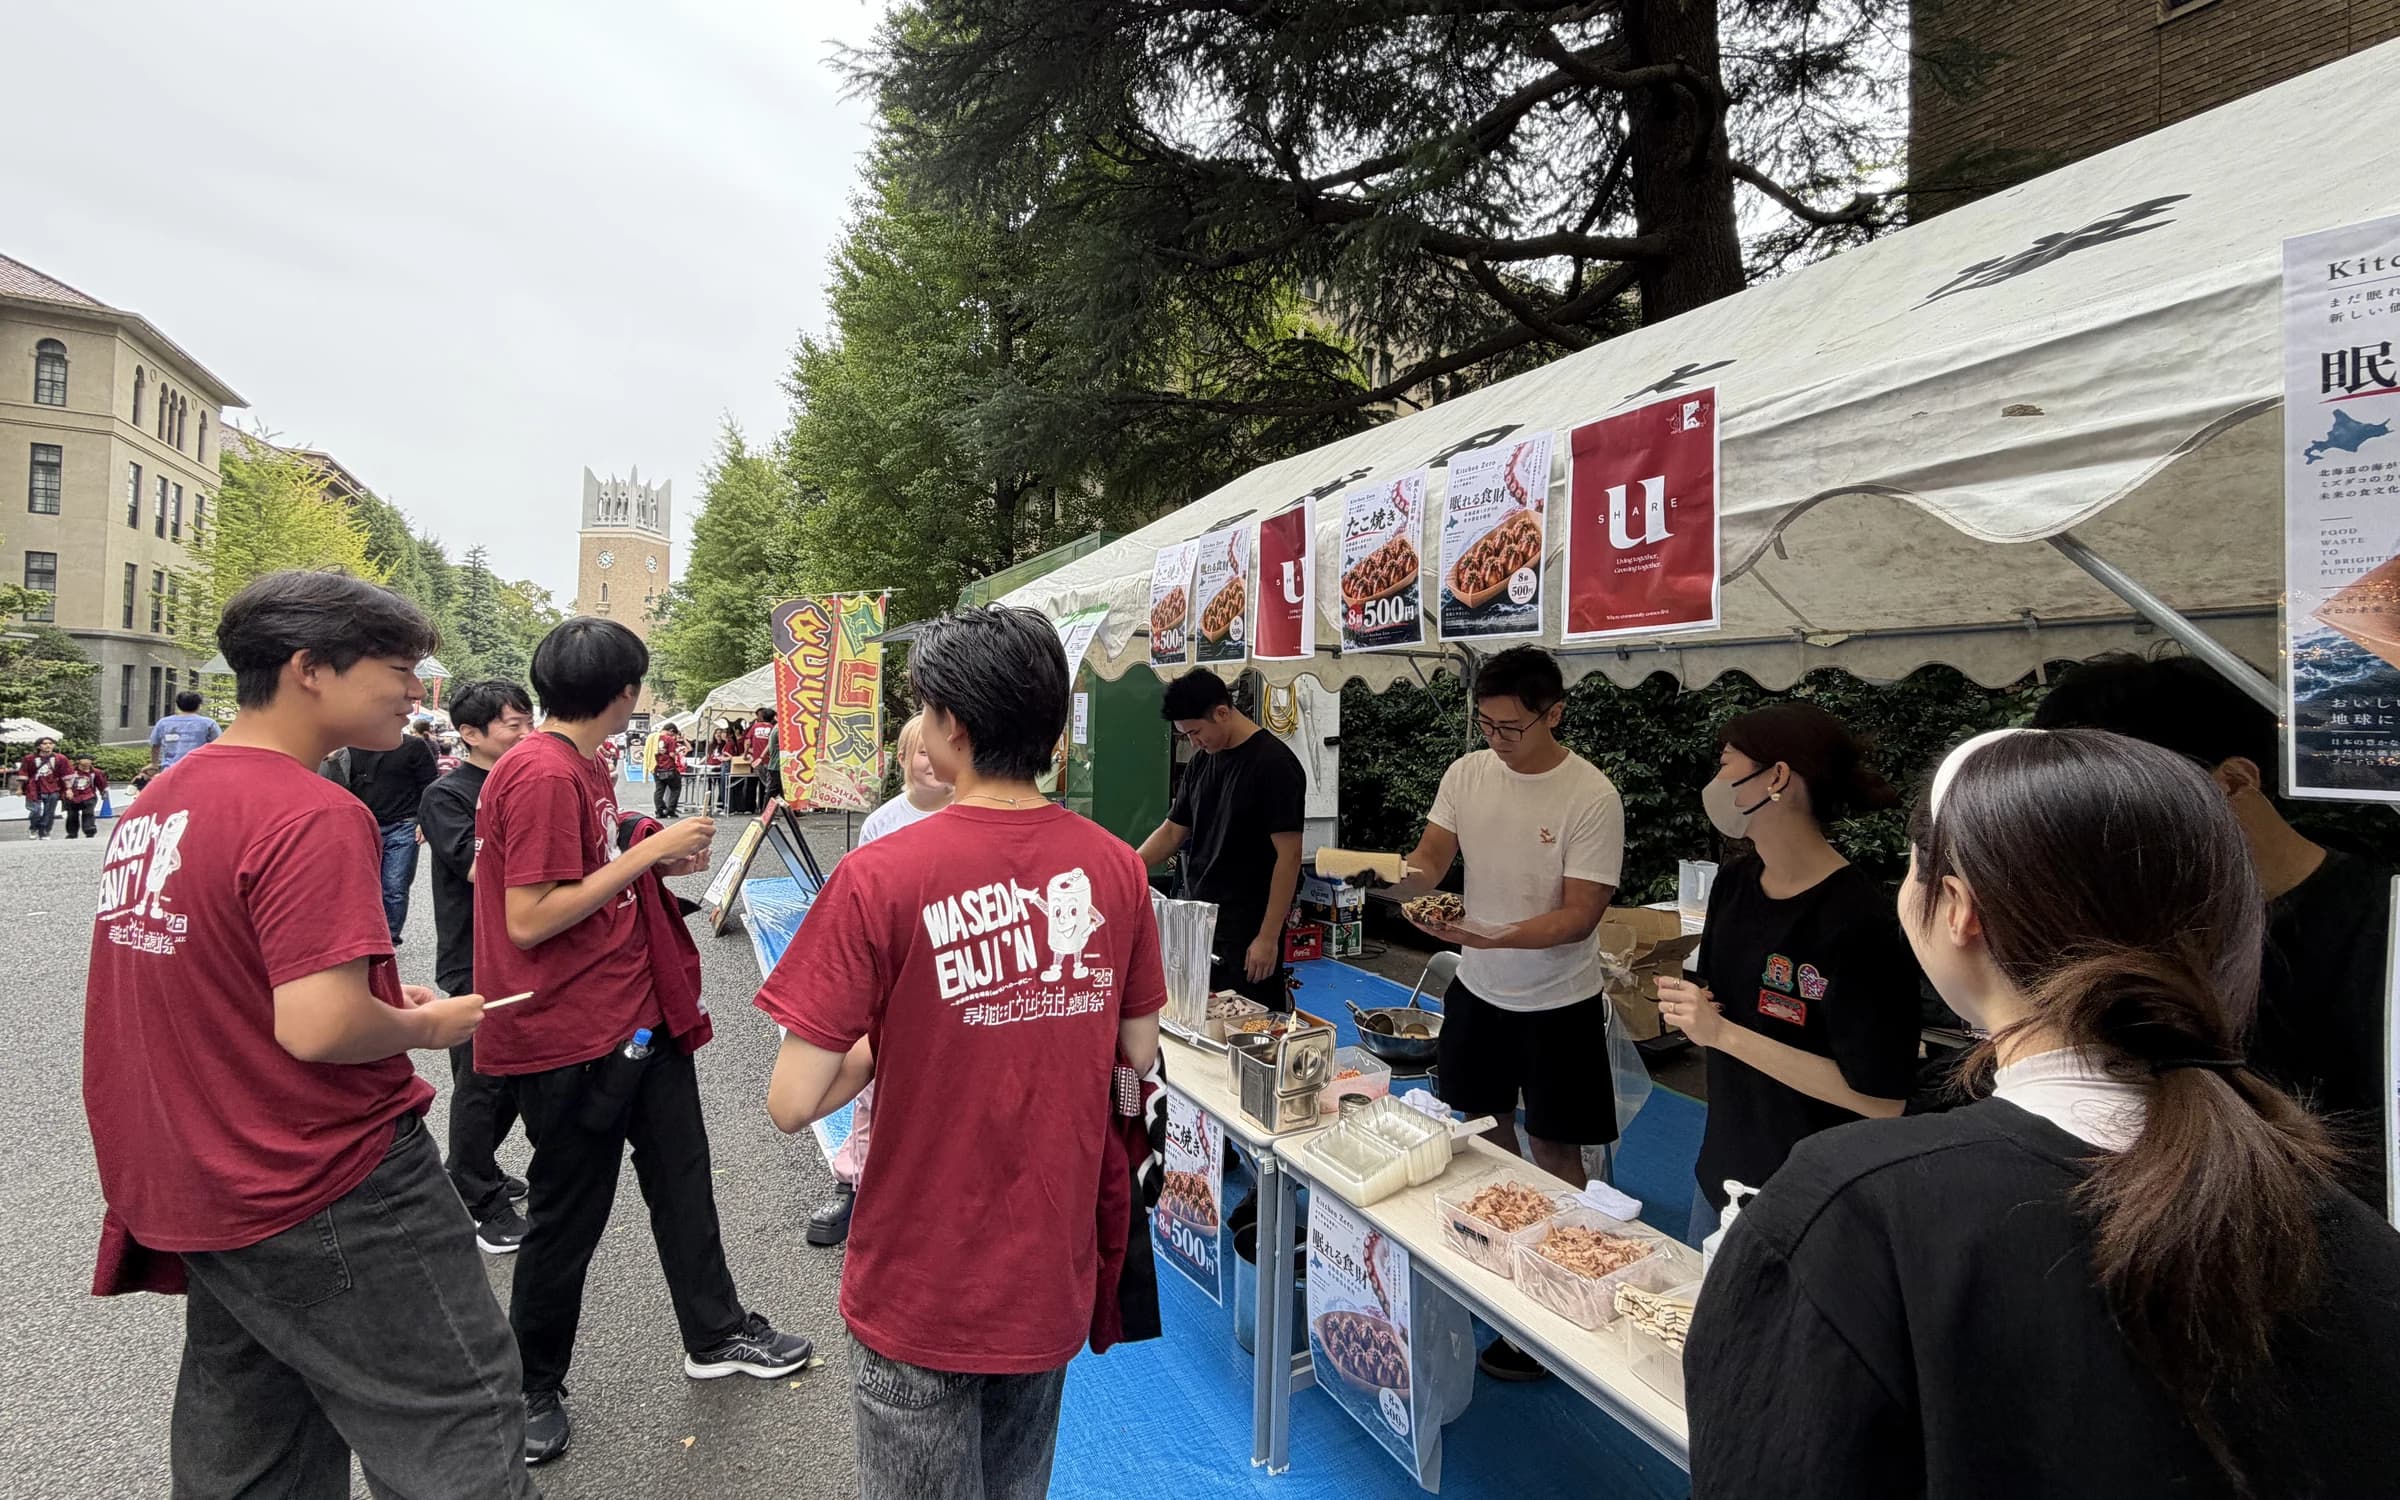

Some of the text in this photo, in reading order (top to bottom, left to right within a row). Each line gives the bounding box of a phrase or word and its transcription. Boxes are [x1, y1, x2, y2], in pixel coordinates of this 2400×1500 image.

[2321, 341, 2397, 394] 眠
[1481, 461, 1496, 469] Zero
[1450, 485, 1506, 510] 眠れる食財
[1346, 508, 1396, 537] たこ焼き
[2320, 527, 2358, 536] FOOD
[2320, 538, 2366, 546] WASTE
[2320, 548, 2339, 556] TO
[1364, 595, 1415, 627] 500円
[2331, 698, 2400, 709] おいし
[922, 877, 1030, 949] WASEDA
[1315, 1195, 1338, 1218] Kitchen
[1339, 1213, 1354, 1230] Zero
[1171, 1217, 1215, 1275] 500円
[1312, 1228, 1367, 1290] 眠れる食財
